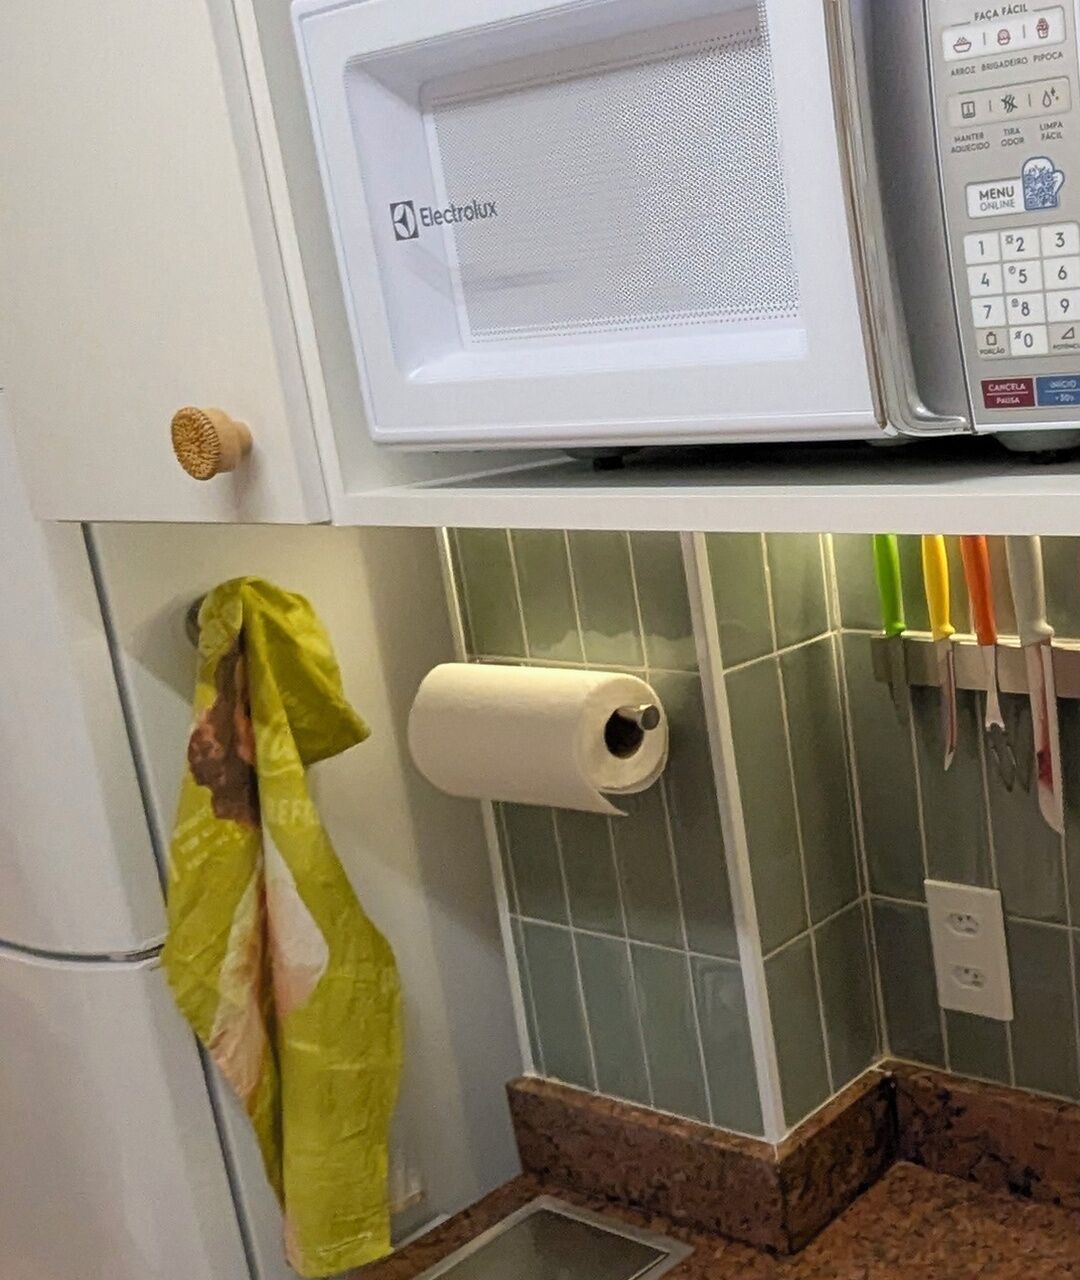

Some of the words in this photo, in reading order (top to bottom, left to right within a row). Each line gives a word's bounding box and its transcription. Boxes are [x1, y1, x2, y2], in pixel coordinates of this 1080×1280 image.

[974, 9, 999, 22] FAÇA
[951, 65, 976, 77] ARROZ
[981, 57, 1028, 71] BRIGADEIRO
[1033, 51, 1064, 63] PIPOCA
[954, 132, 984, 143] MANTER
[1004, 128, 1021, 136] TIRA
[1040, 122, 1063, 131] LIMPA
[951, 141, 990, 154] AQUECIDO
[1001, 137, 1025, 148] ODOR
[979, 186, 1015, 201] MENU
[419, 200, 498, 227] Electrolux
[980, 199, 1016, 212] ONLINE
[978, 240, 985, 256] 1
[1016, 237, 1025, 252] 2
[1055, 232, 1066, 248] 3
[981, 273, 990, 288] 4
[1018, 269, 1028, 284] 5
[1057, 265, 1068, 280] 6
[983, 305, 992, 319] 7
[1021, 301, 1031, 316] 8
[1060, 298, 1070, 314] 9
[1024, 333, 1033, 348] 0
[988, 382, 1025, 392] CANCELA
